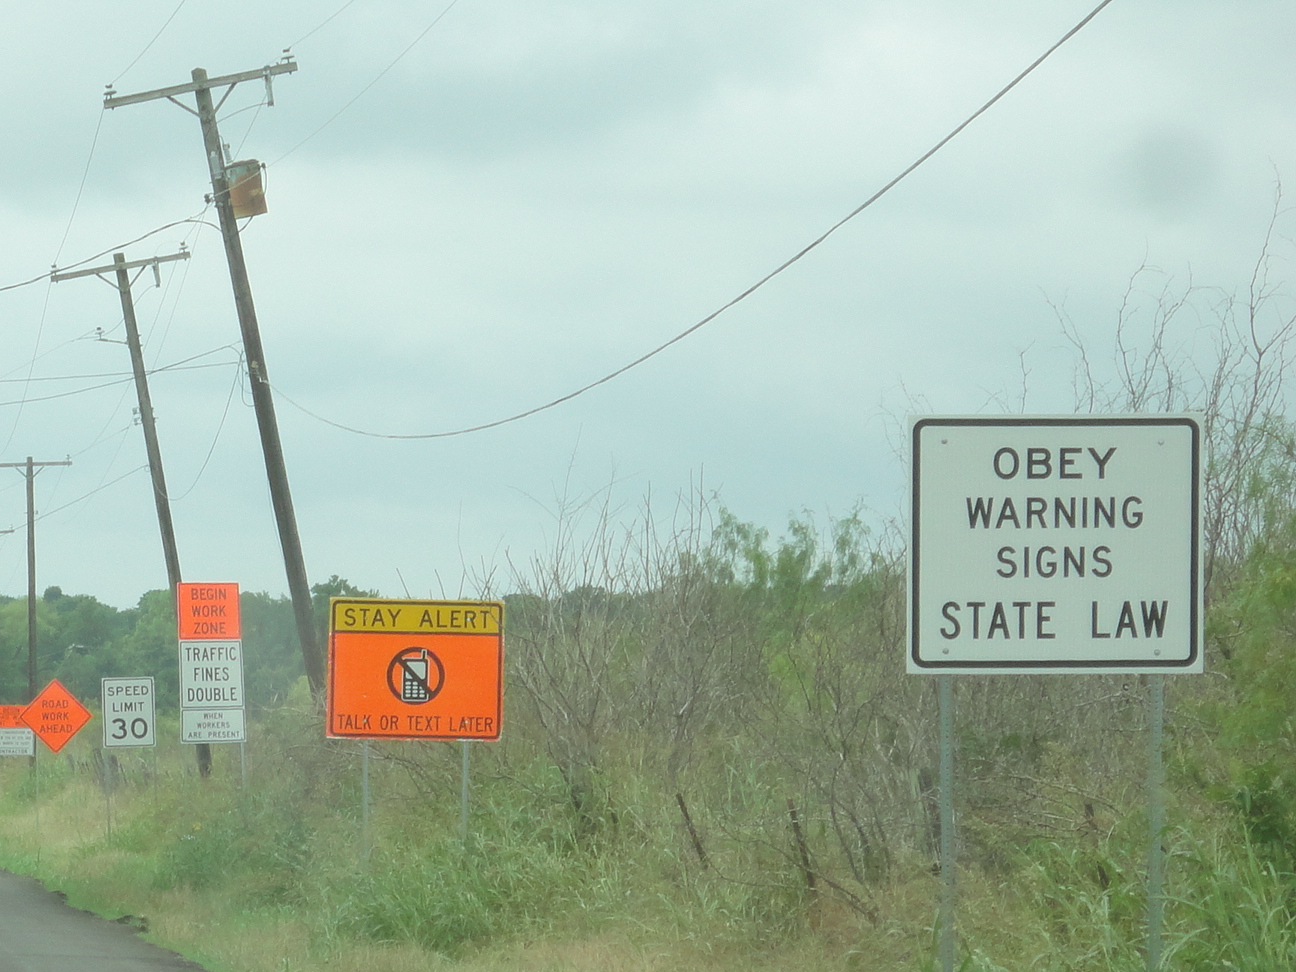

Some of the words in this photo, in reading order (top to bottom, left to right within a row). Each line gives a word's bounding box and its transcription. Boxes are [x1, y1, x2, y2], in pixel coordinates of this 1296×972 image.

[993, 446, 1117, 480] OBEY
[965, 496, 1144, 529] WARNING
[996, 545, 1113, 579] SIGNS
[191, 588, 227, 600] BEGIN
[191, 605, 227, 617] WORK
[344, 607, 402, 628] STAY
[418, 609, 491, 629] ALERT
[939, 601, 1056, 640] STATE
[1091, 600, 1168, 639] LAW
[193, 622, 227, 635] ZONE
[185, 646, 237, 662] TRAFFIC
[193, 667, 230, 682] FINES
[107, 685, 149, 696] SPEED
[187, 687, 238, 702] DOUBLE
[41, 699, 69, 709] ROAD
[112, 701, 145, 713] LIMIT
[41, 711, 69, 721] WORK
[203, 712, 223, 720] WHEN
[39, 723, 73, 734] AHEAD
[111, 717, 149, 740] 30
[197, 721, 231, 729] WORKERS
[337, 714, 372, 730] TALK
[379, 714, 399, 731] OR
[406, 715, 442, 732] TEXT
[449, 716, 493, 733] LATER
[187, 731, 202, 739] ARE
[207, 730, 240, 739] PRESENT
